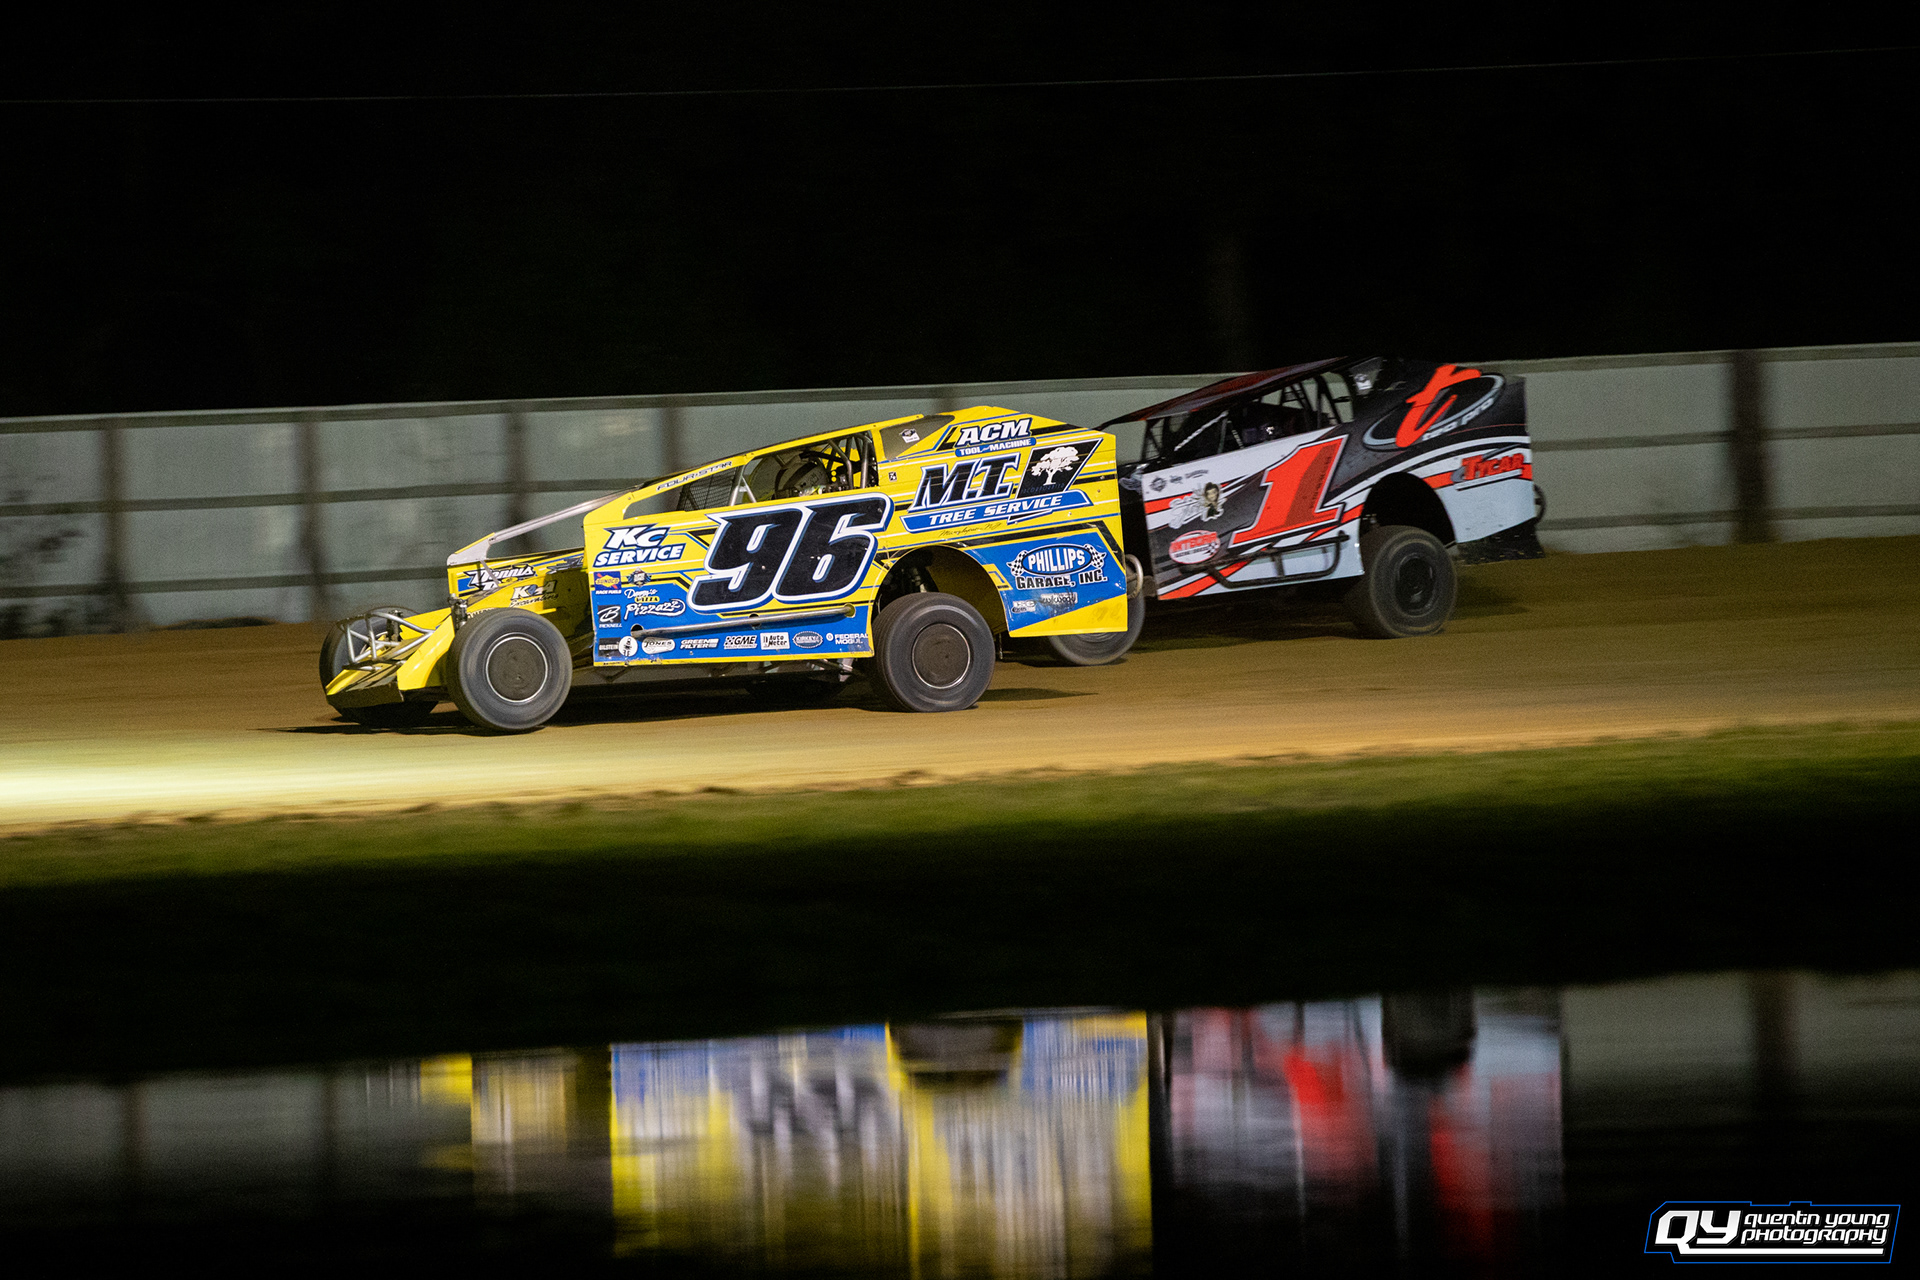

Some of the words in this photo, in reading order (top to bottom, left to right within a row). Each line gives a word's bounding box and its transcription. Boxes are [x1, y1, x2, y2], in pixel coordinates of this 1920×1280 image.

[956, 418, 1032, 447] ACM
[960, 446, 980, 456] TOOL
[989, 439, 1032, 451] MACHINE
[1228, 434, 1349, 548] 1
[929, 509, 977, 525] TREE
[984, 495, 1063, 516] SERVICE
[604, 523, 671, 550] KC
[593, 543, 686, 567] SERVICE
[687, 492, 894, 614] 96
[1027, 547, 1086, 572] PHILLIPS
[1016, 575, 1076, 590] GARAGE,
[1079, 568, 1108, 585] INC.
[644, 640, 672, 648] JONES
[734, 635, 757, 645] GME
[835, 632, 868, 640] FEDERAL
